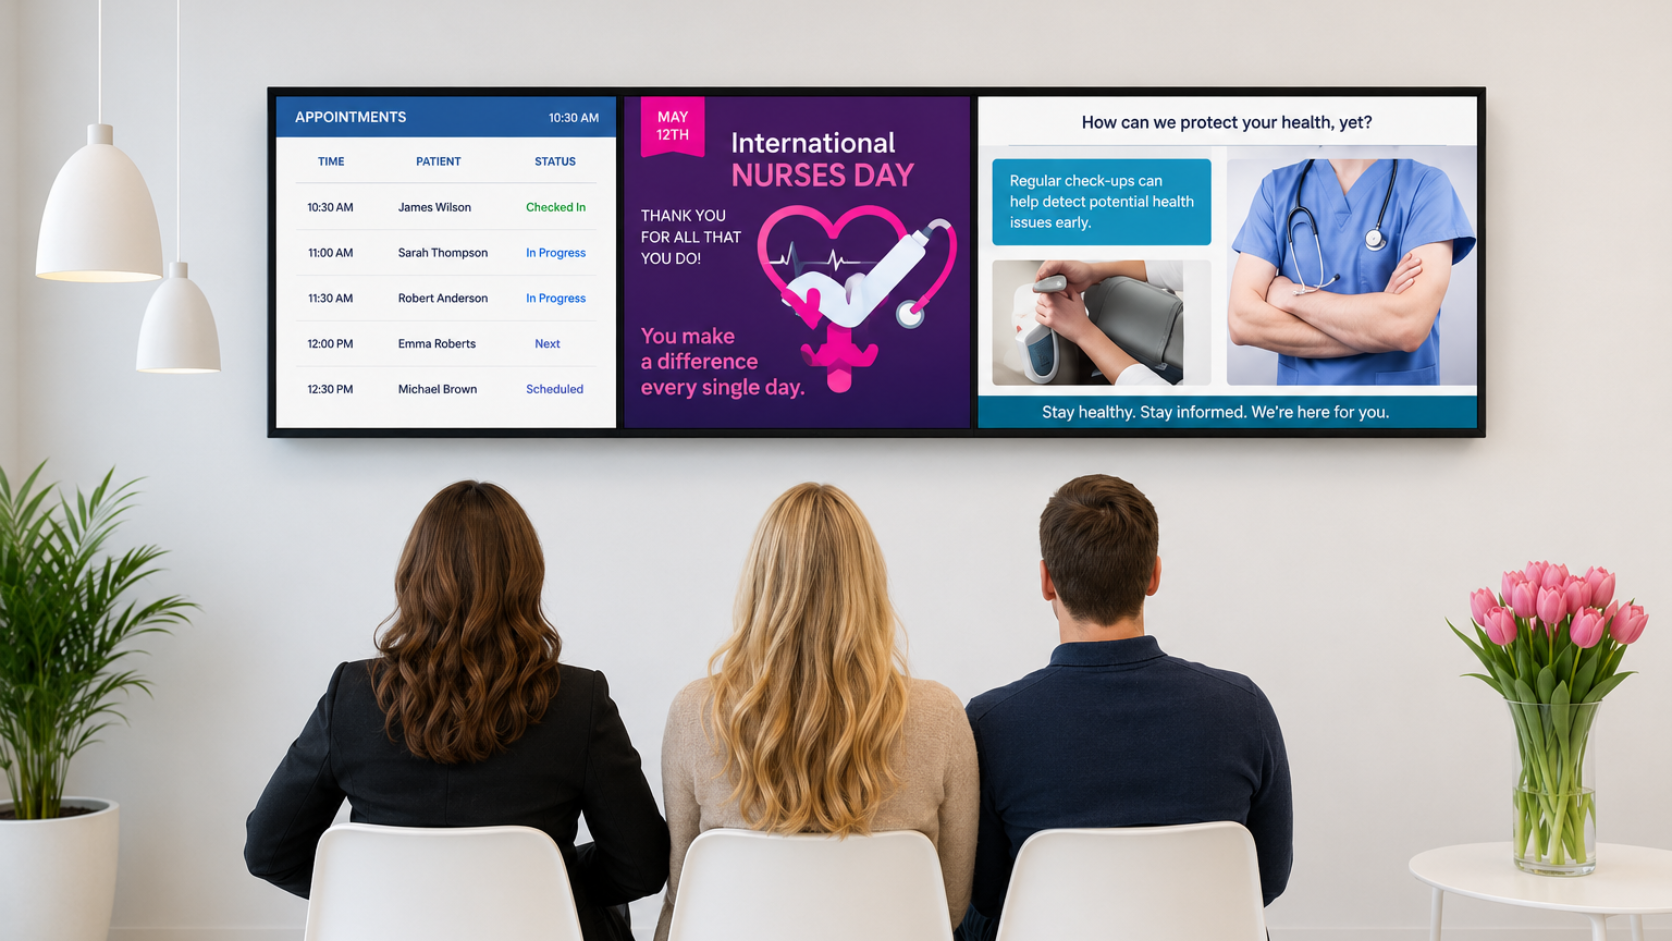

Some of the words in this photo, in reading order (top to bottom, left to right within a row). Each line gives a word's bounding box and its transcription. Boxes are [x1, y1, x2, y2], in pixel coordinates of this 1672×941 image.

[295, 111, 406, 122] APPOINTMENTS
[549, 113, 578, 122] 10:30
[581, 113, 599, 122] AM
[658, 111, 688, 122] MAY
[1083, 115, 1117, 129] How
[1121, 119, 1149, 129] can
[1154, 119, 1176, 129] we
[1181, 116, 1238, 132] protect
[1242, 119, 1277, 132] your
[1282, 115, 1335, 131] health,
[1339, 115, 1372, 132] yet?
[657, 129, 688, 140] 12TH
[733, 132, 895, 153] International
[318, 157, 344, 166] TIME
[417, 157, 461, 166] PATIENT
[535, 157, 576, 166] STATUS
[733, 163, 846, 187] NURSES
[855, 163, 914, 186] DAY
[1011, 174, 1062, 190] Regular
[1065, 174, 1134, 189] check-ups
[1138, 177, 1162, 186] can
[308, 202, 334, 212] 10:30
[336, 203, 353, 212] AM
[398, 203, 433, 212] James
[435, 202, 471, 212] Wilson
[526, 202, 573, 212] Checked
[577, 202, 586, 212] In
[1011, 195, 1039, 210] help
[1043, 195, 1086, 207] detect
[1090, 195, 1148, 210] potential
[1153, 195, 1194, 207] health
[641, 209, 691, 221] THANK
[695, 209, 725, 222] YOU
[1011, 216, 1052, 228] issues
[1056, 216, 1091, 231] early.
[642, 231, 670, 243] FOR
[674, 231, 700, 243] ALL
[704, 231, 741, 243] THAT
[309, 248, 333, 257] 11:00
[335, 248, 353, 257] AM
[399, 248, 428, 257] Sarah
[431, 248, 488, 259] Thompson
[527, 248, 536, 257] In
[539, 248, 586, 260] Progress
[641, 252, 671, 264] YOU
[676, 252, 700, 264] DO!
[309, 293, 333, 303] 11:30
[335, 293, 353, 303] AM
[399, 293, 434, 303] Robert
[437, 293, 488, 303] Anderson
[527, 293, 536, 303] In
[539, 293, 586, 305] Progress
[641, 328, 676, 344] You
[683, 327, 735, 344] make
[308, 339, 334, 348] 12:00
[337, 339, 353, 348] PM
[399, 339, 431, 348] Emma
[435, 339, 476, 348] Roberts
[535, 339, 560, 348] Next
[641, 357, 652, 369] a
[658, 352, 758, 369] difference
[308, 384, 334, 394] 12:30
[337, 384, 353, 394] PM
[399, 384, 440, 394] Michael
[443, 384, 477, 394] Brown
[527, 384, 583, 394] Scheduled
[641, 382, 697, 399] every
[703, 378, 760, 400] single
[765, 378, 805, 399] day.
[1043, 405, 1075, 422] Stay
[1079, 405, 1136, 422] healthy.
[1141, 405, 1172, 422] Stay
[1177, 405, 1247, 418] informed.
[1252, 405, 1293, 418] We're
[1298, 405, 1330, 418] here
[1334, 405, 1355, 418] for
[1359, 408, 1389, 422] you.
